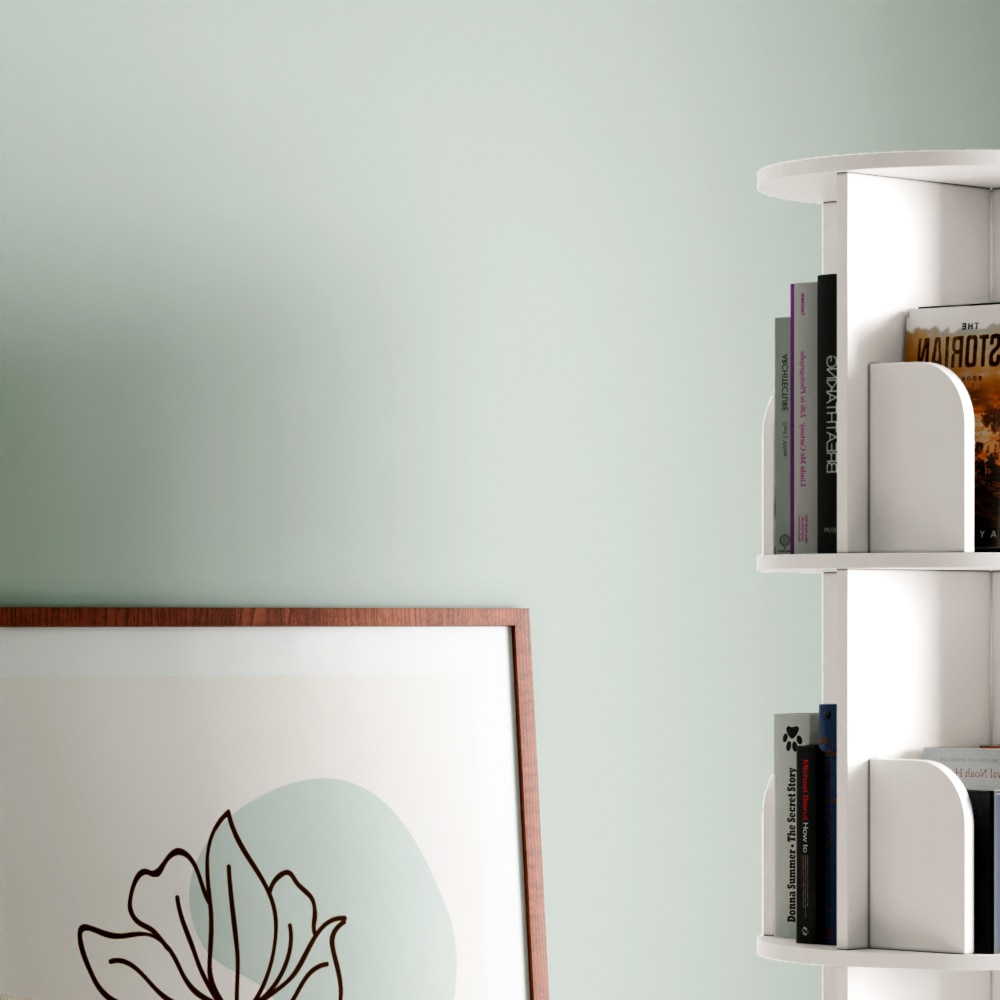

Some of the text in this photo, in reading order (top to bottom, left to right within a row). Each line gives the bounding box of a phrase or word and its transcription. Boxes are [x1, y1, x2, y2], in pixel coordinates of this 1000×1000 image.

[787, 768, 797, 922] Donna Summer The Secret Story
[803, 844, 808, 853] to
